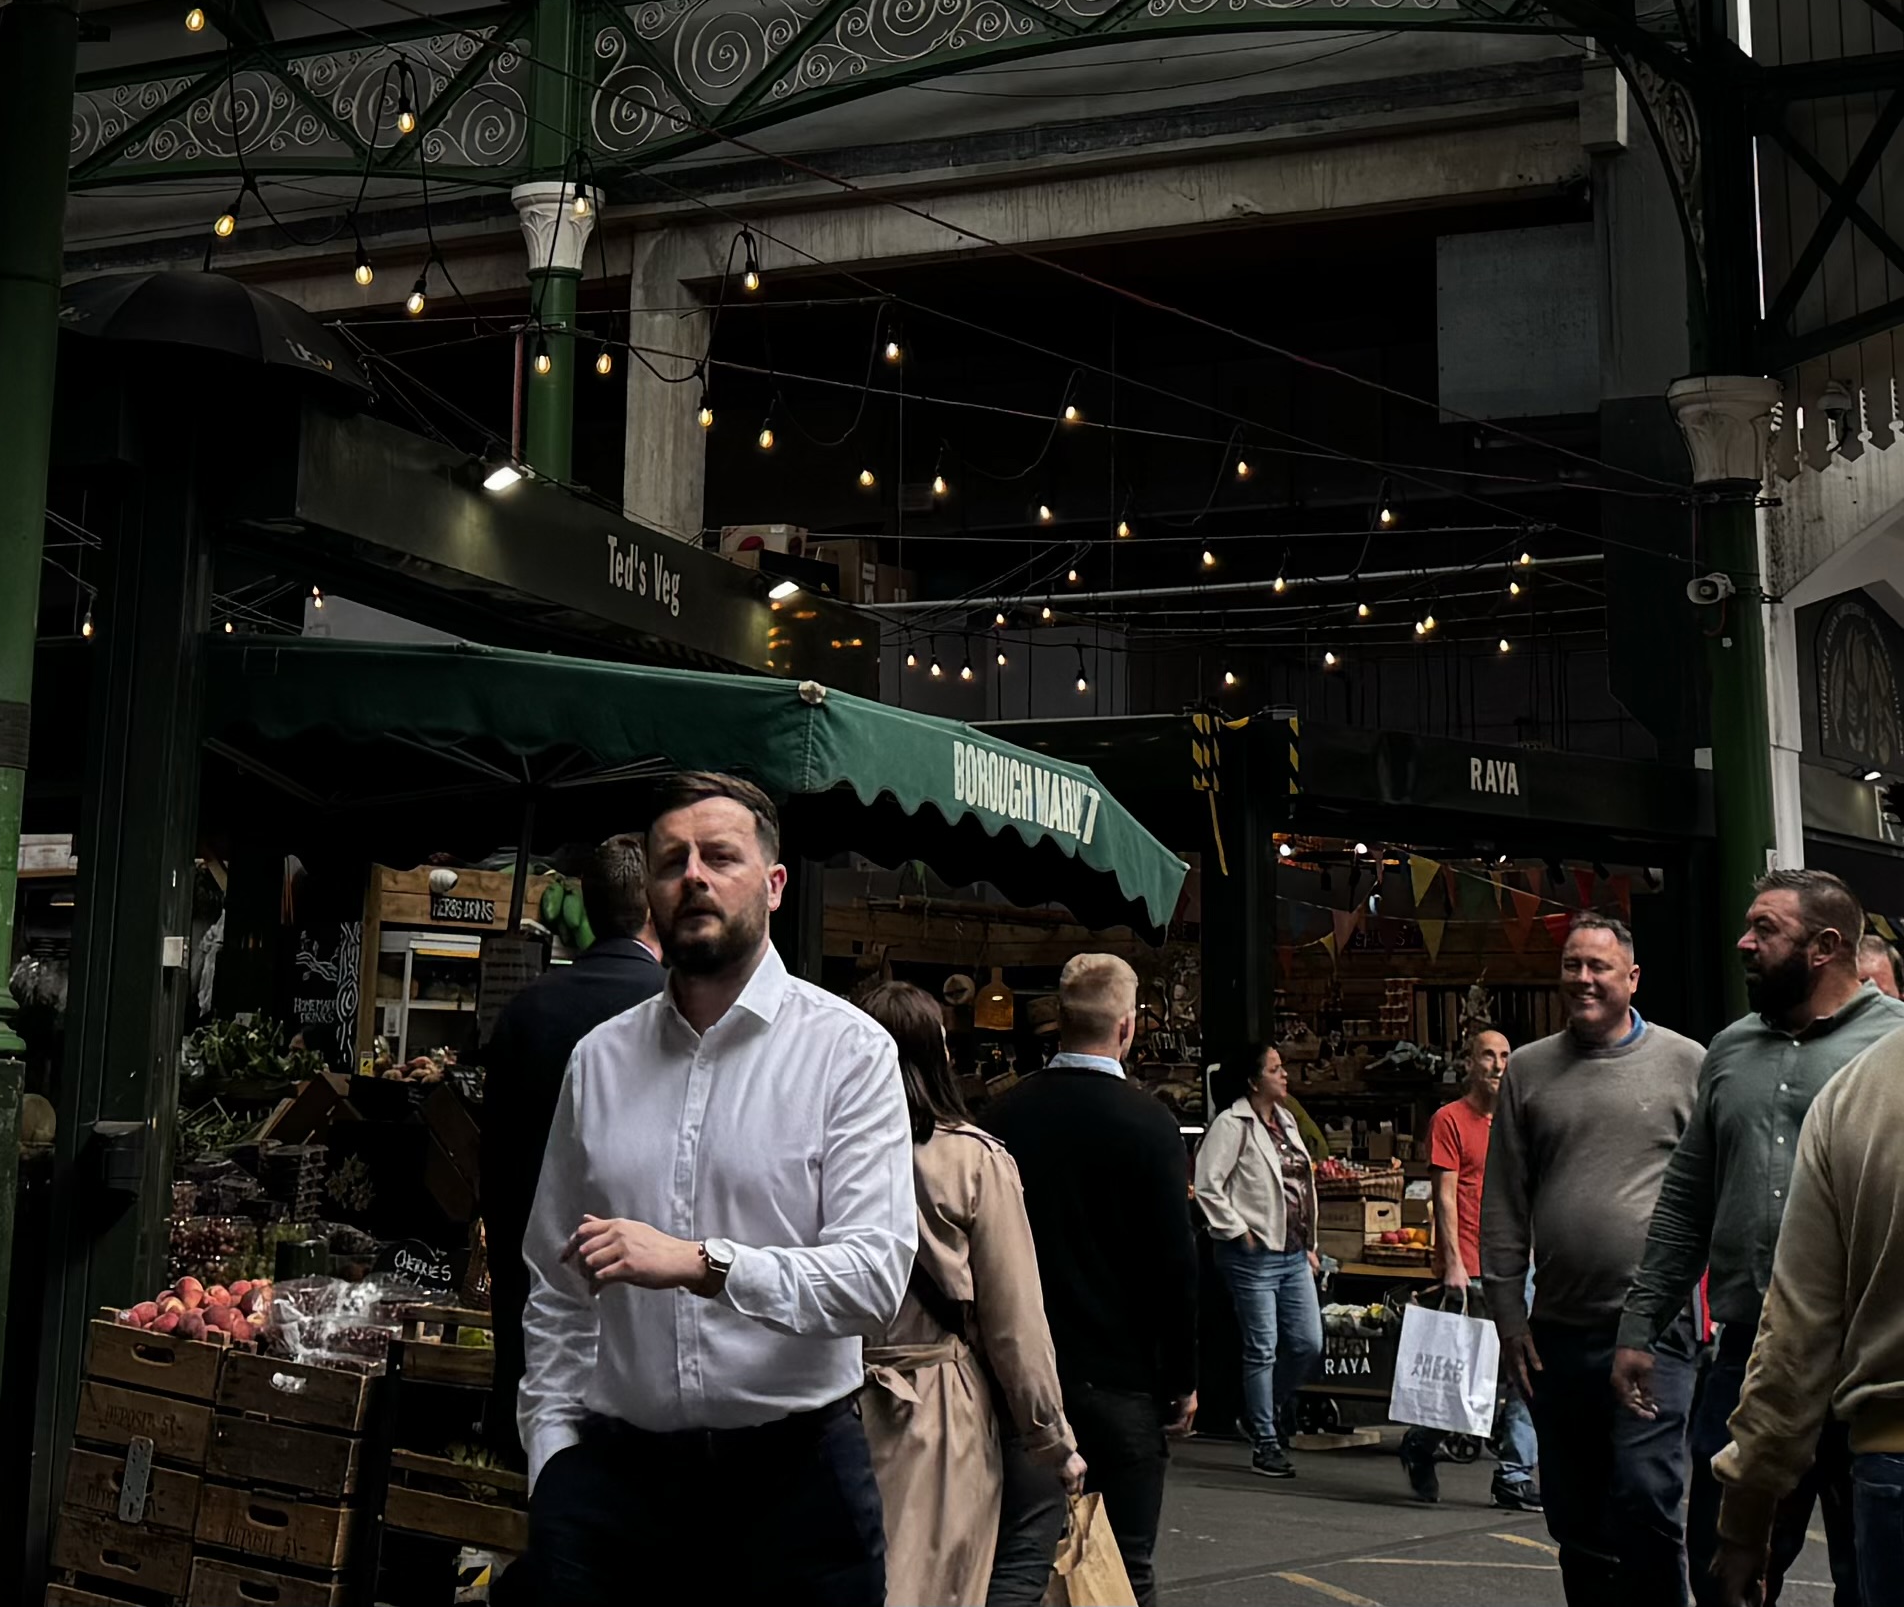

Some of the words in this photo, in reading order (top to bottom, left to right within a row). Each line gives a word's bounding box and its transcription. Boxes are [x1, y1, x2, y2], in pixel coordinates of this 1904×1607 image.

[607, 534, 647, 597] Ted's
[653, 551, 681, 618] Veg
[953, 740, 1034, 822] BOROUGH
[1469, 756, 1520, 797] RAYA
[394, 1249, 452, 1281] CHERRIES
[1324, 1356, 1371, 1375] RAYA
[1410, 1366, 1463, 1385] AHEAD
[1414, 1353, 1465, 1372] BREAD
[105, 1403, 155, 1434] DEPOSIT
